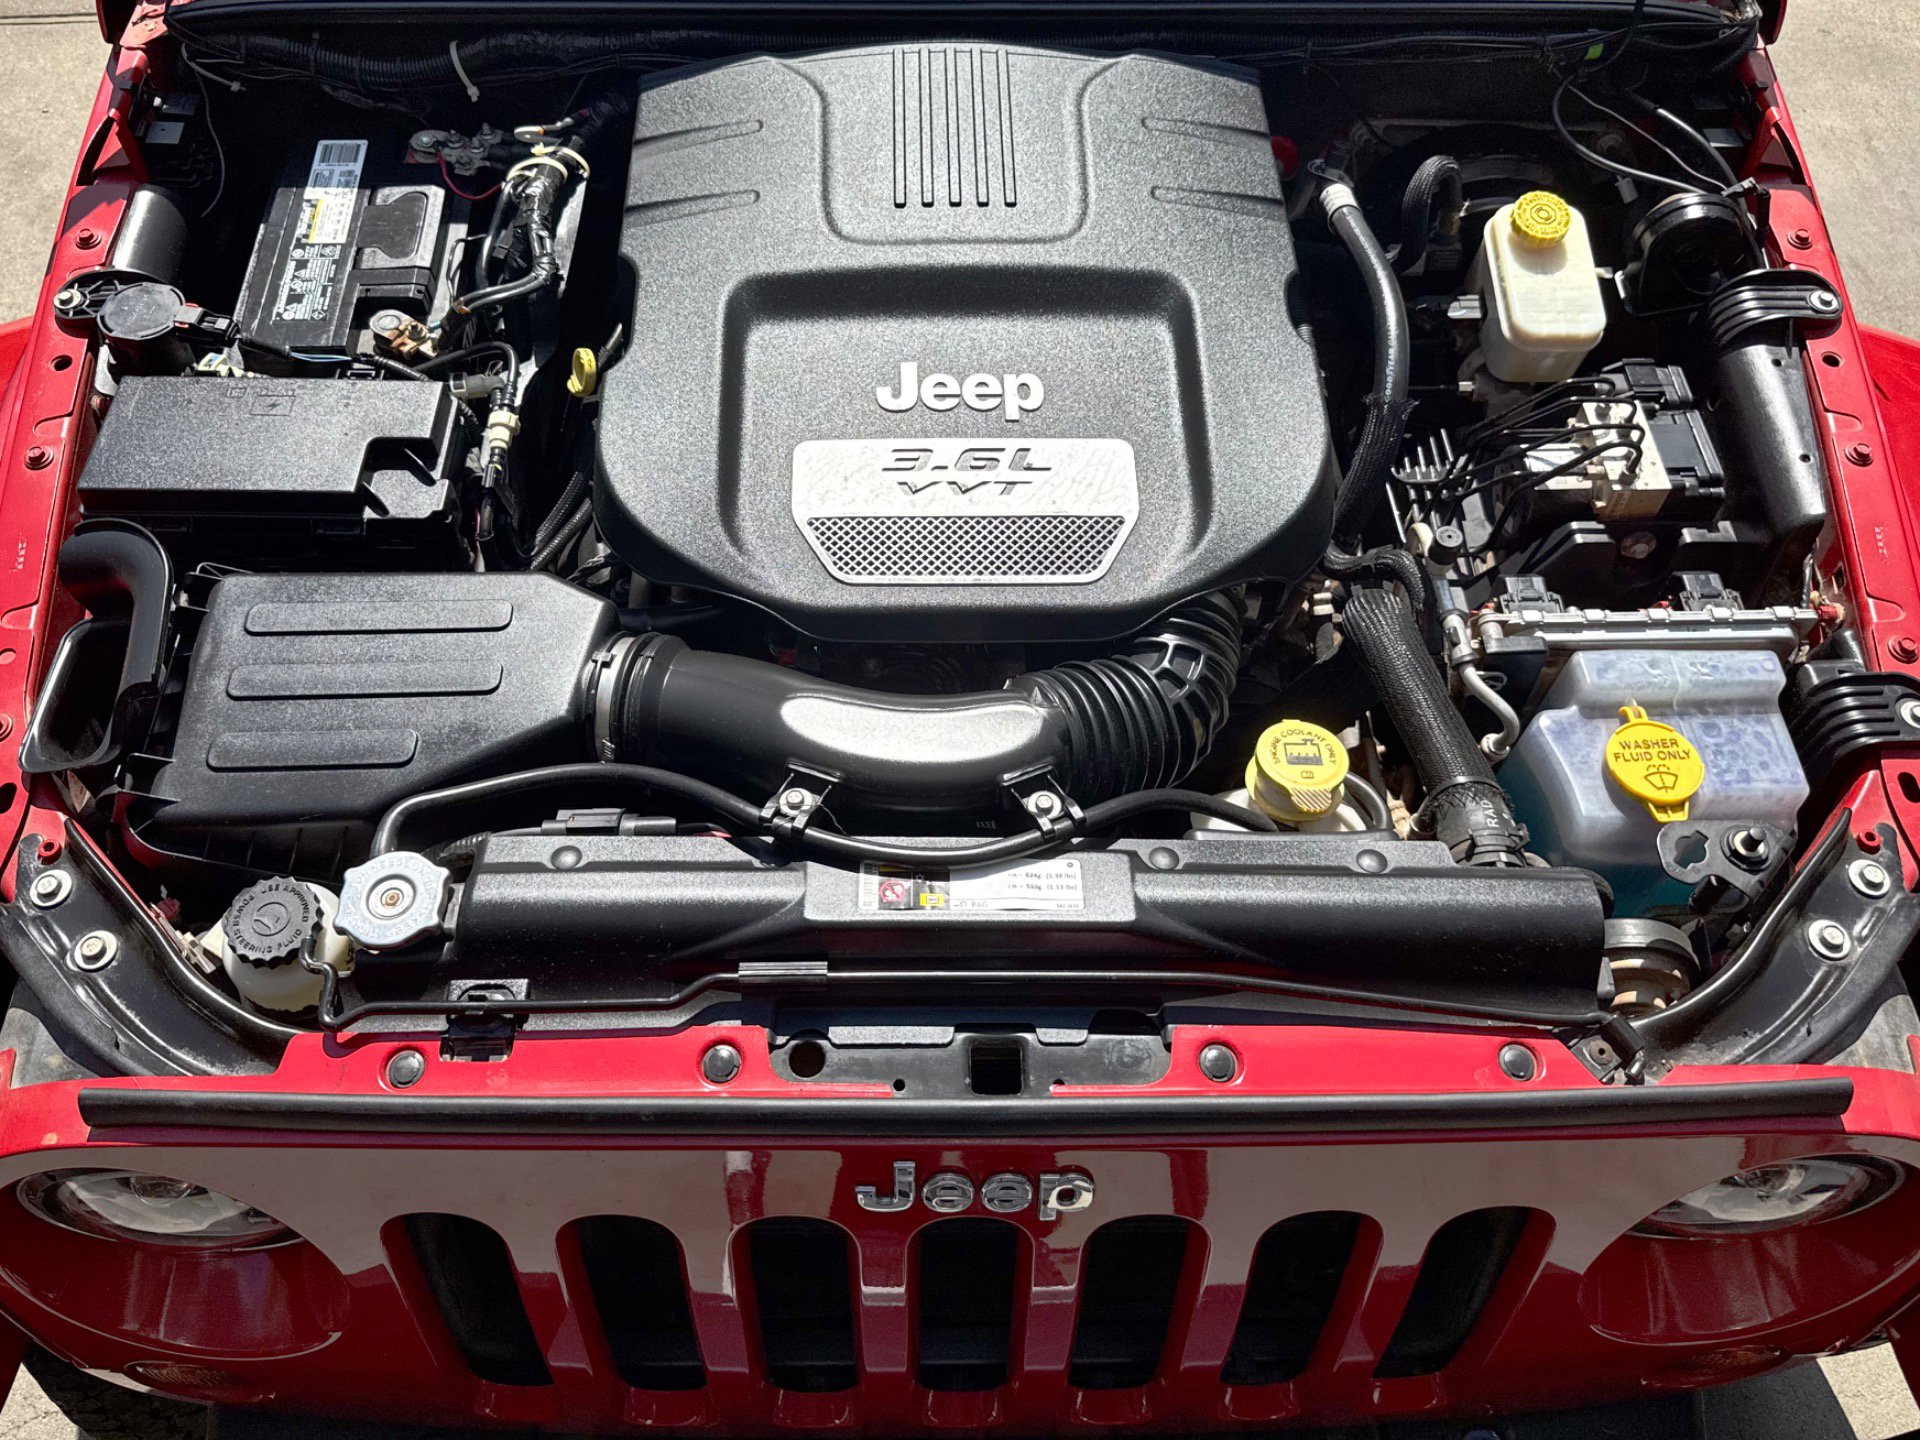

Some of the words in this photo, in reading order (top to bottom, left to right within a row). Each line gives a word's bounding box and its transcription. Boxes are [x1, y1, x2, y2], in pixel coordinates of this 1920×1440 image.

[875, 361, 1045, 423] Jeep
[881, 447, 1052, 472] 3.6L
[896, 480, 1033, 496] VVT
[1281, 728, 1326, 742] COOLANT
[1325, 743, 1337, 765] ONLY
[1613, 751, 1653, 762] FLUID
[1657, 749, 1691, 761] ONLY
[1619, 738, 1679, 751] WASHER
[1480, 799, 1500, 828] RAD
[282, 885, 310, 922] APPROVED
[232, 928, 273, 954] STEERING
[277, 928, 302, 951] FLUID
[855, 1160, 1095, 1221] Jeep
